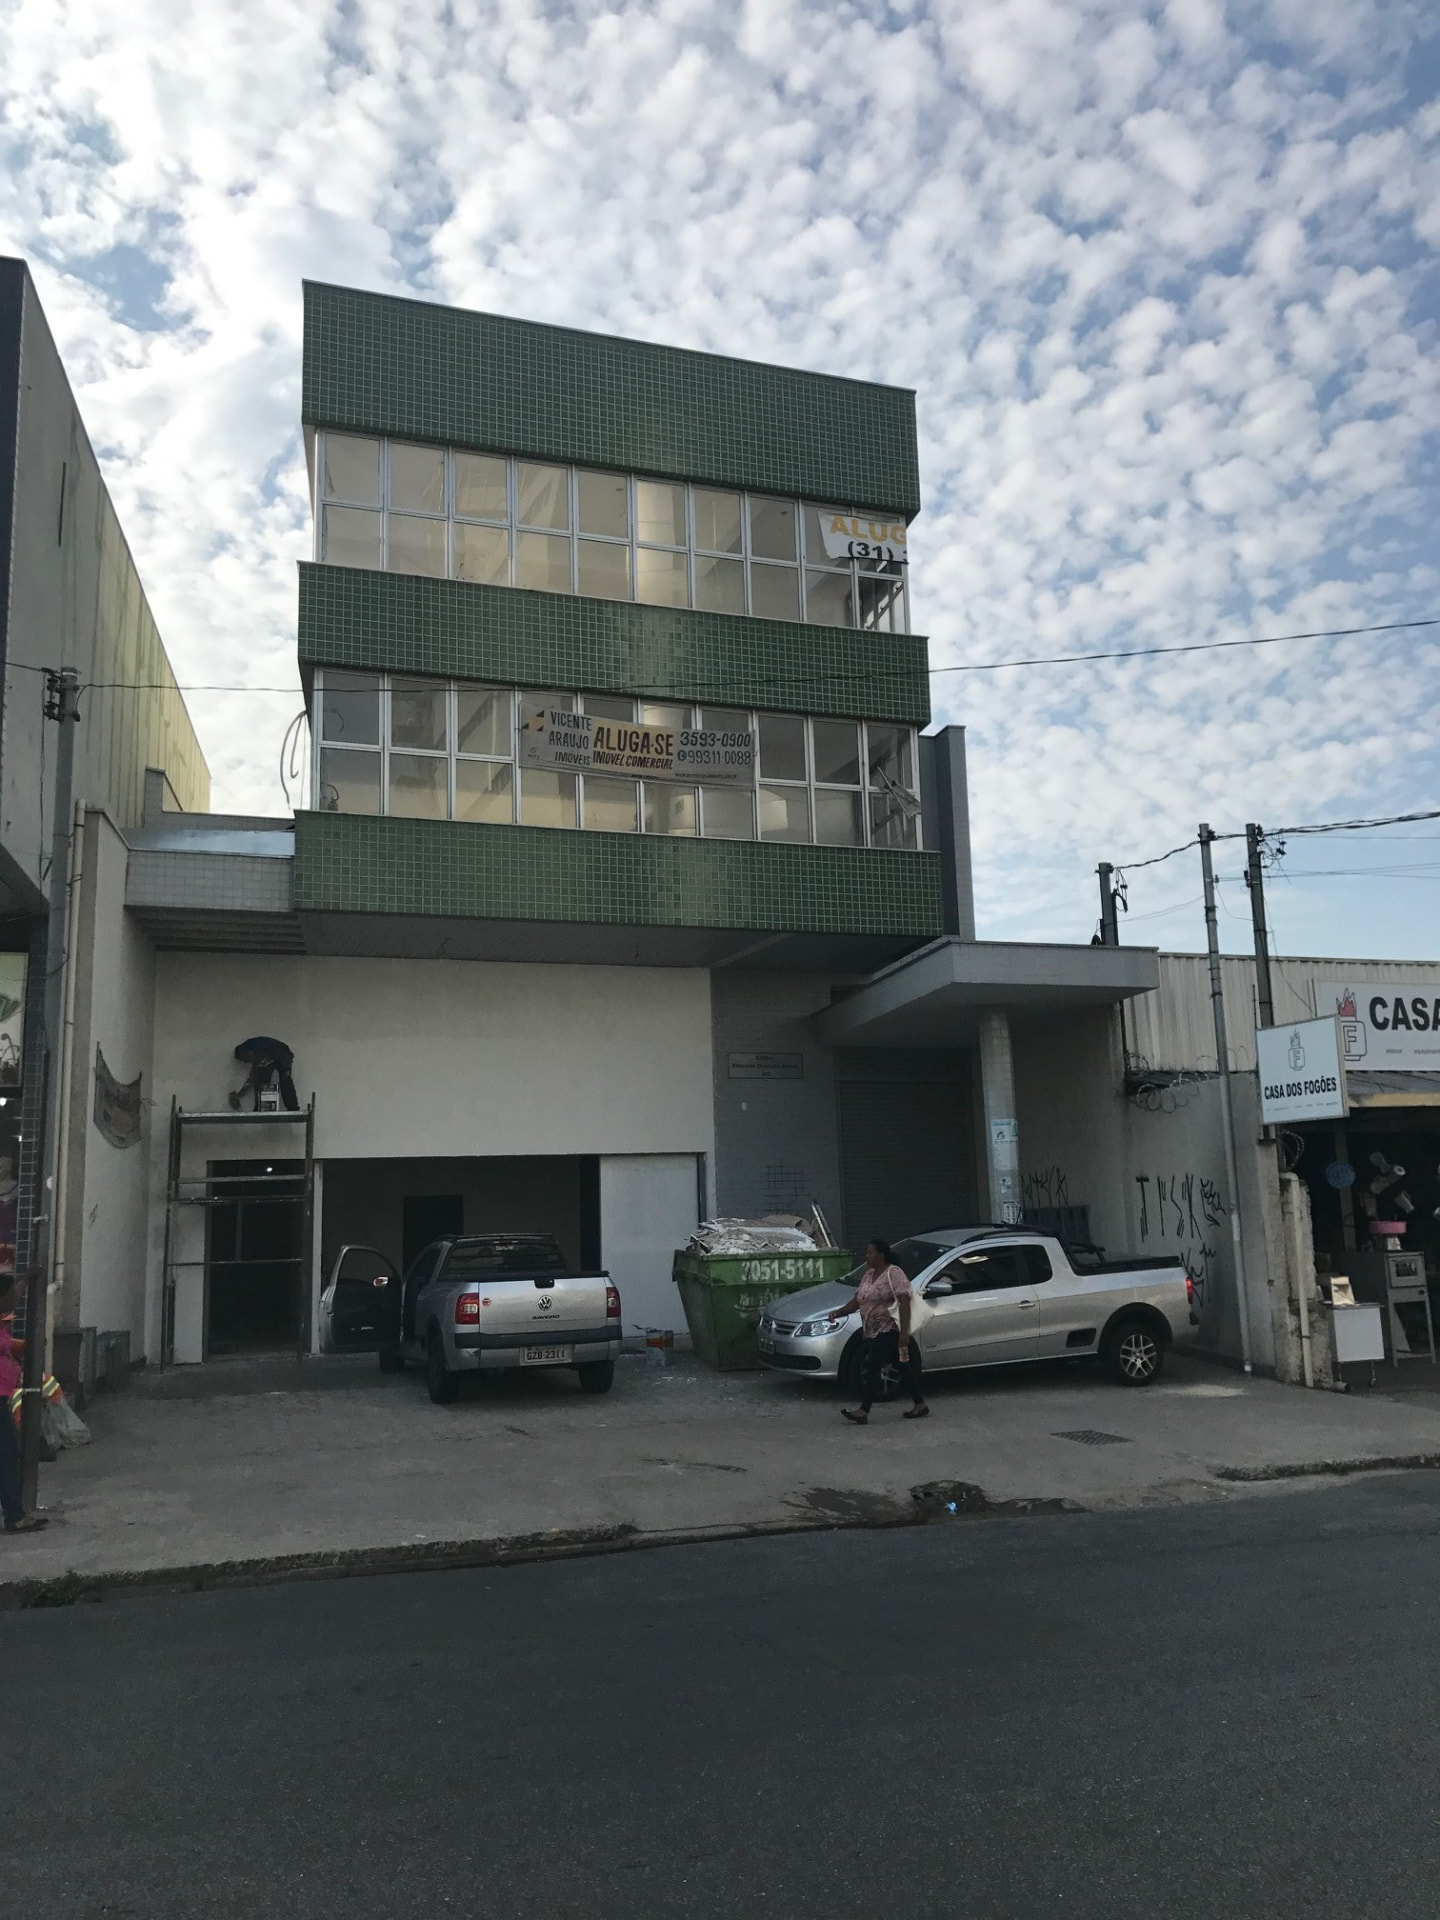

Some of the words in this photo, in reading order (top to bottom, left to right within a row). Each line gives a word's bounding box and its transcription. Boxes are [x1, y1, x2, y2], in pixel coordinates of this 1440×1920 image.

[550, 710, 592, 732] VICENTE
[548, 730, 590, 750] ARAUJO
[680, 731, 751, 747] 3593-0900
[626, 755, 674, 770] COMERCIAL
[1264, 1082, 1285, 1100] CASA
[1286, 1080, 1303, 1098] DOS
[1304, 1075, 1337, 1095] FOGÕES
